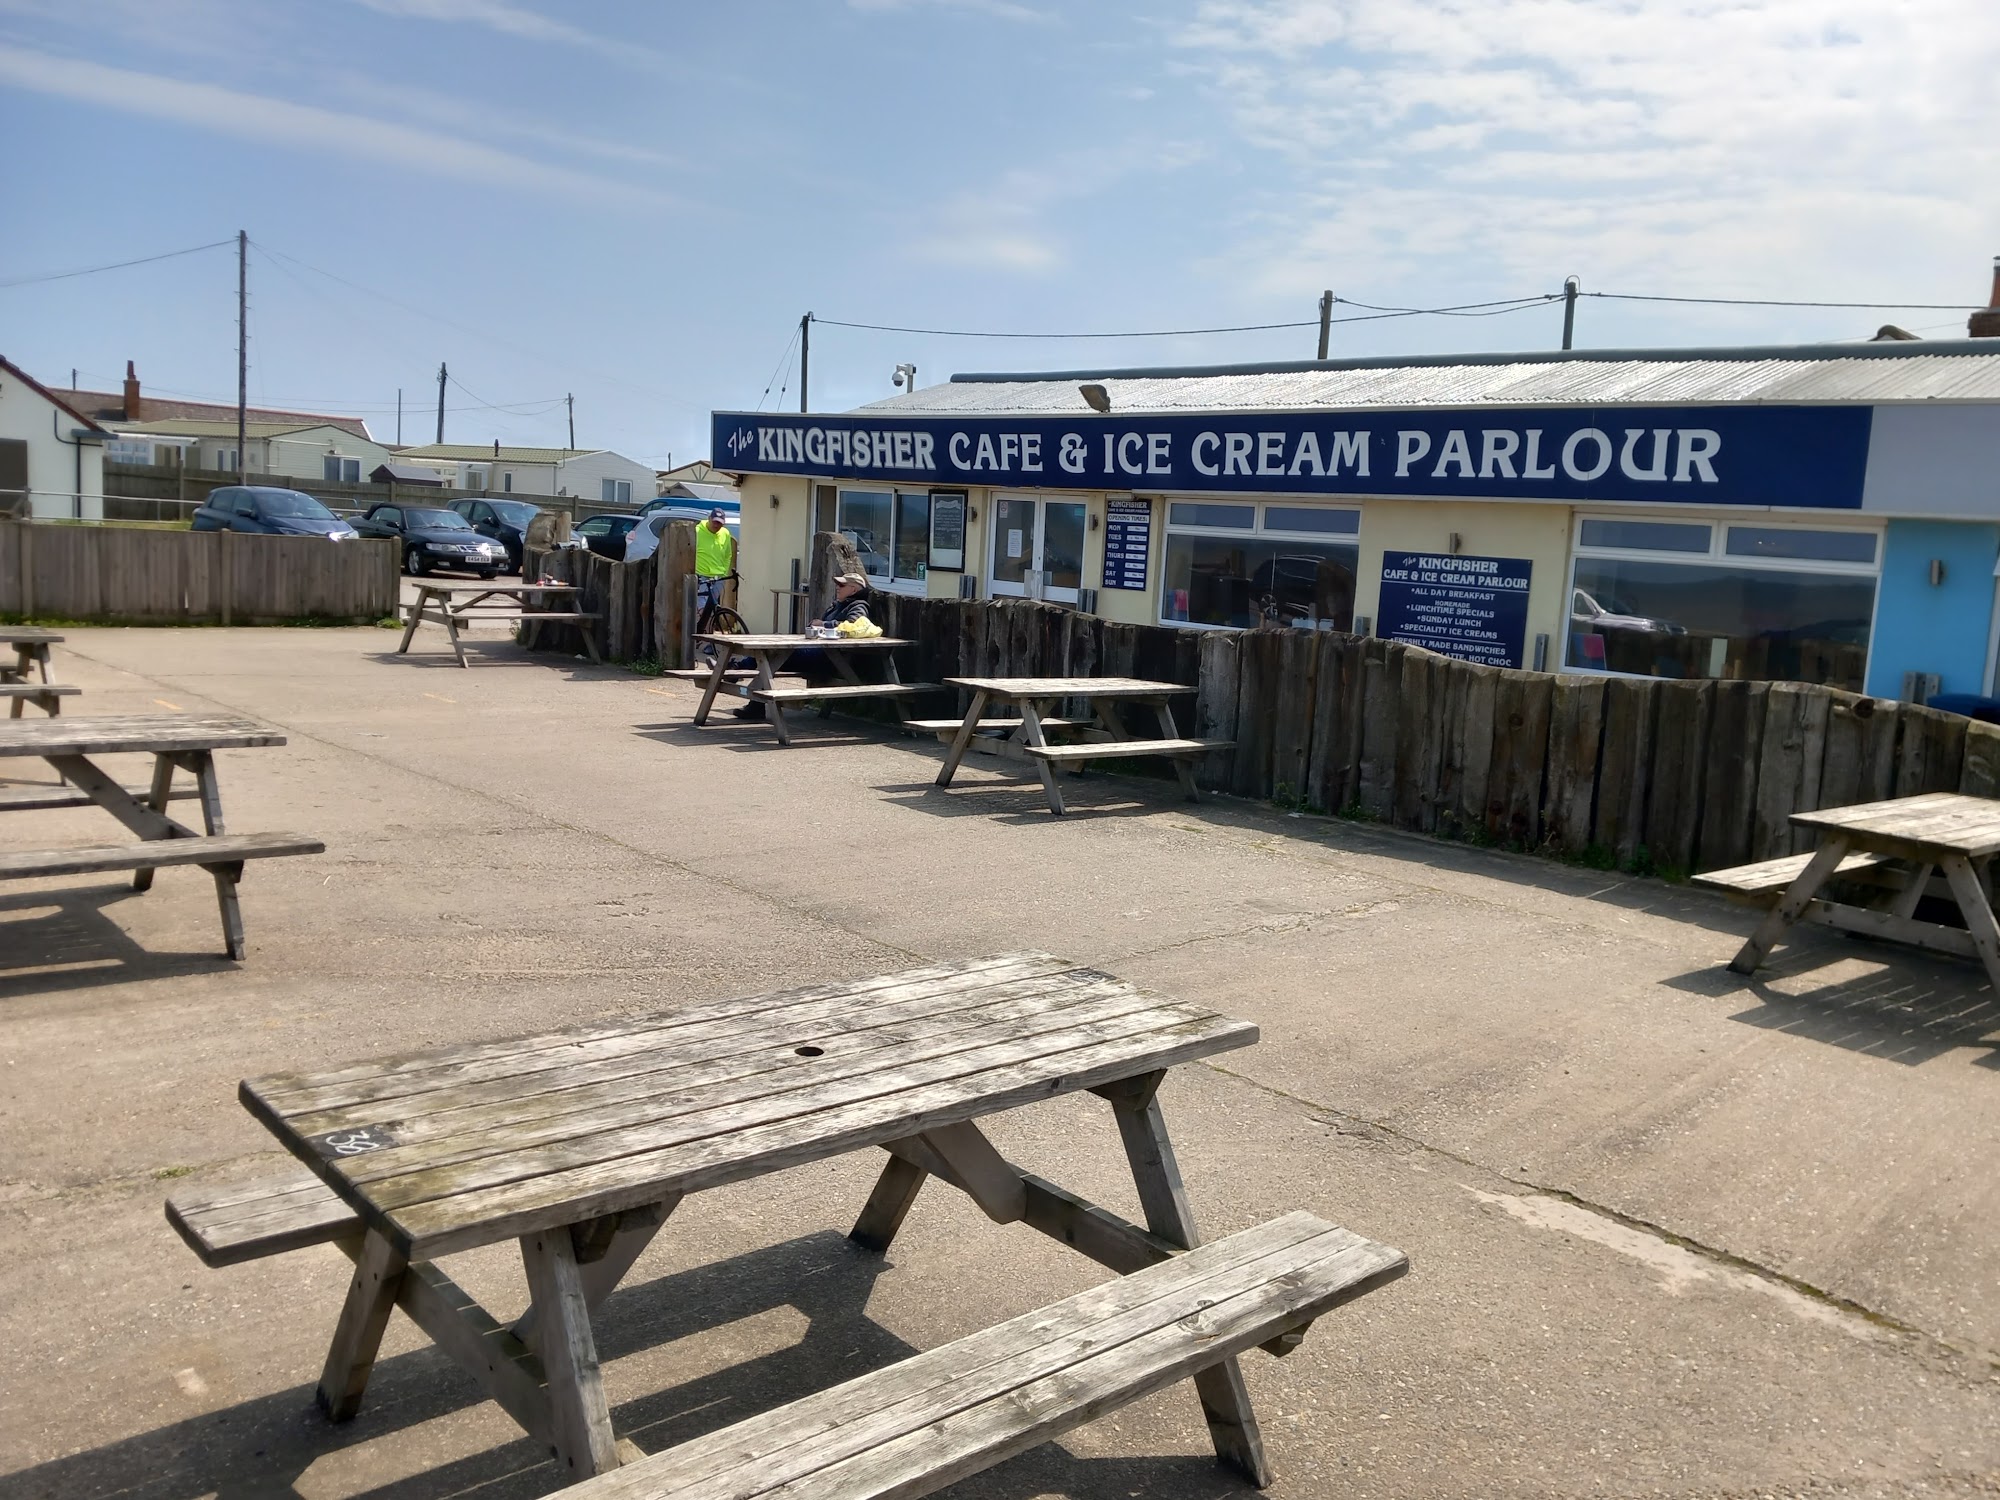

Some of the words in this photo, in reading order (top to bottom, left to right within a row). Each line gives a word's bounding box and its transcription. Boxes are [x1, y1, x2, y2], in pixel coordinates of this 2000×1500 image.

[727, 428, 754, 458] The
[757, 427, 938, 471] KINGFISHER
[948, 431, 1043, 473] CAFE
[1058, 432, 1089, 474] &
[1103, 431, 1173, 475] ICE
[1190, 430, 1372, 478] CREAM
[1394, 427, 1722, 483] PARLOUR
[1402, 557, 1416, 566] The
[1418, 557, 1498, 573] KINGFISHER
[1383, 569, 1408, 580] CAFE
[1410, 570, 1419, 581] &
[1421, 571, 1437, 582] ICE
[1440, 572, 1475, 585] CREAM
[1478, 575, 1528, 589] PARLOUR
[1430, 589, 1447, 597] DAY
[1449, 590, 1495, 600] BREAKFAST
[1410, 604, 1454, 614] LUNCHTIME
[1456, 607, 1495, 618] SPECIALS
[1434, 600, 1471, 608] HOMEMADE
[1421, 615, 1452, 624] SUNDAY
[1454, 618, 1481, 627] LUNCH
[1404, 623, 1447, 634] SPECIALITY
[1449, 627, 1462, 636] ICE
[1464, 629, 1498, 639] CREAMS
[1428, 641, 1451, 649] MADE
[1453, 642, 1506, 655] SANDWICHES
[1468, 655, 1486, 663] HOT
[1488, 658, 1512, 667] CHOC
